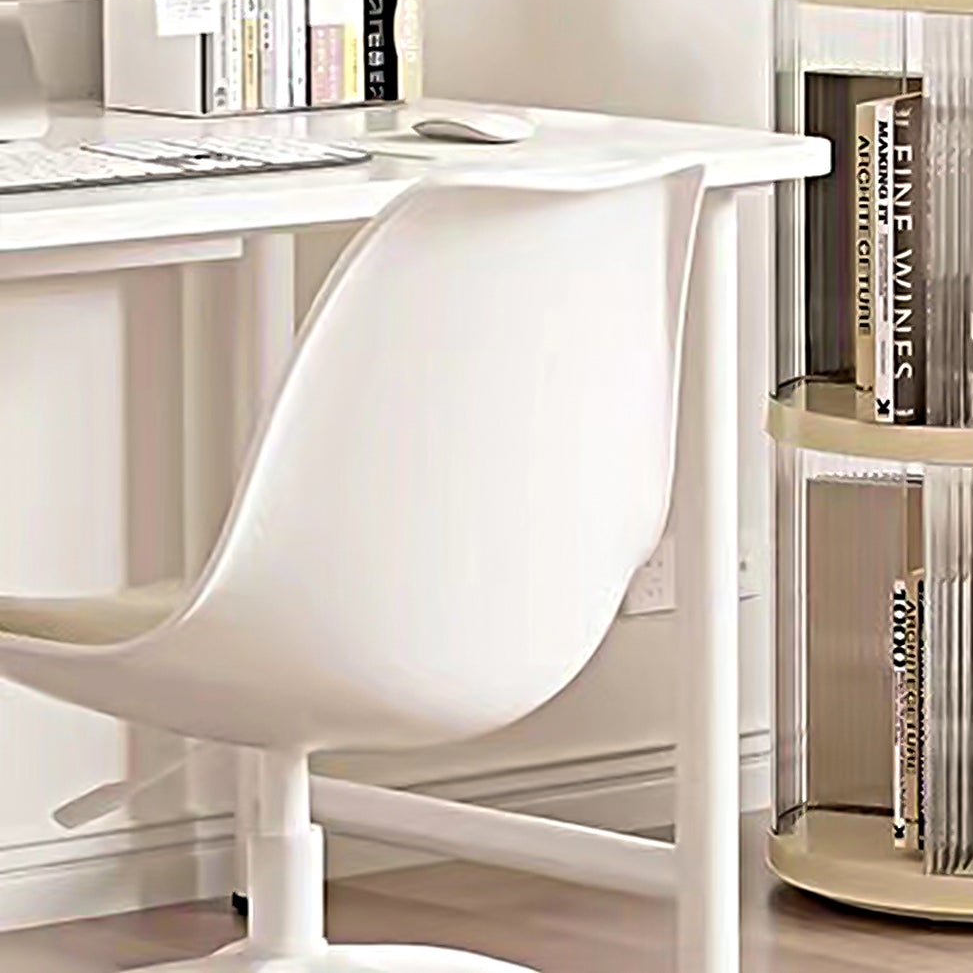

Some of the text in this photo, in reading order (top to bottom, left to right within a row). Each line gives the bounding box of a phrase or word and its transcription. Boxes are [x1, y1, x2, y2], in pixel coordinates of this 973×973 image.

[877, 120, 889, 199] MAKING
[877, 204, 889, 225] IT
[893, 145, 913, 379] FINE WINES
[893, 589, 906, 667] 1000
